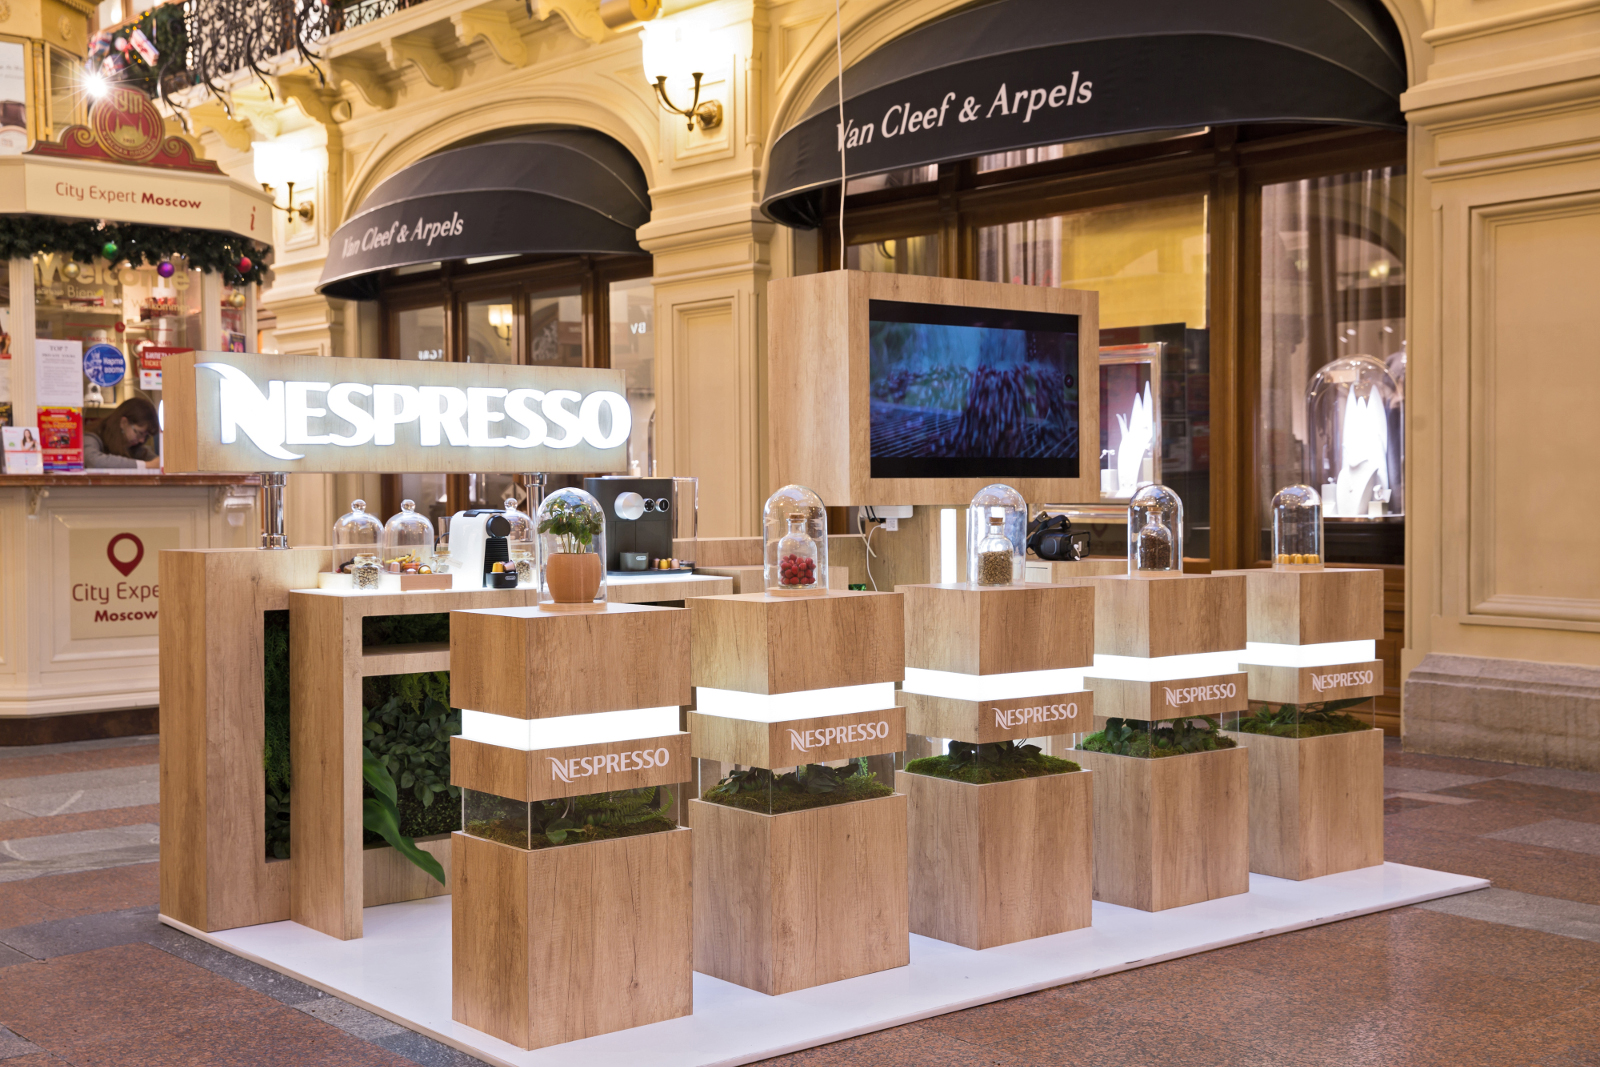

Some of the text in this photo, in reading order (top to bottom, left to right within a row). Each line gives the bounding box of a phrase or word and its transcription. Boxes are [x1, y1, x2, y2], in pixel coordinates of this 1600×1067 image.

[837, 71, 1093, 152] Van Cleef & Arpels
[56, 182, 202, 209] City Expert Moscow
[342, 211, 464, 259] Van Cleef & Arpels
[194, 362, 633, 460] NESPRESSO
[72, 583, 110, 605] City
[94, 609, 158, 623] Moscow
[1161, 682, 1236, 708] NESPRESSO
[1310, 669, 1374, 694] NESPRESSO
[991, 702, 1078, 731] NESPRESSO
[785, 720, 889, 753] NESPRESSO
[545, 747, 670, 783] NESPRESSO
